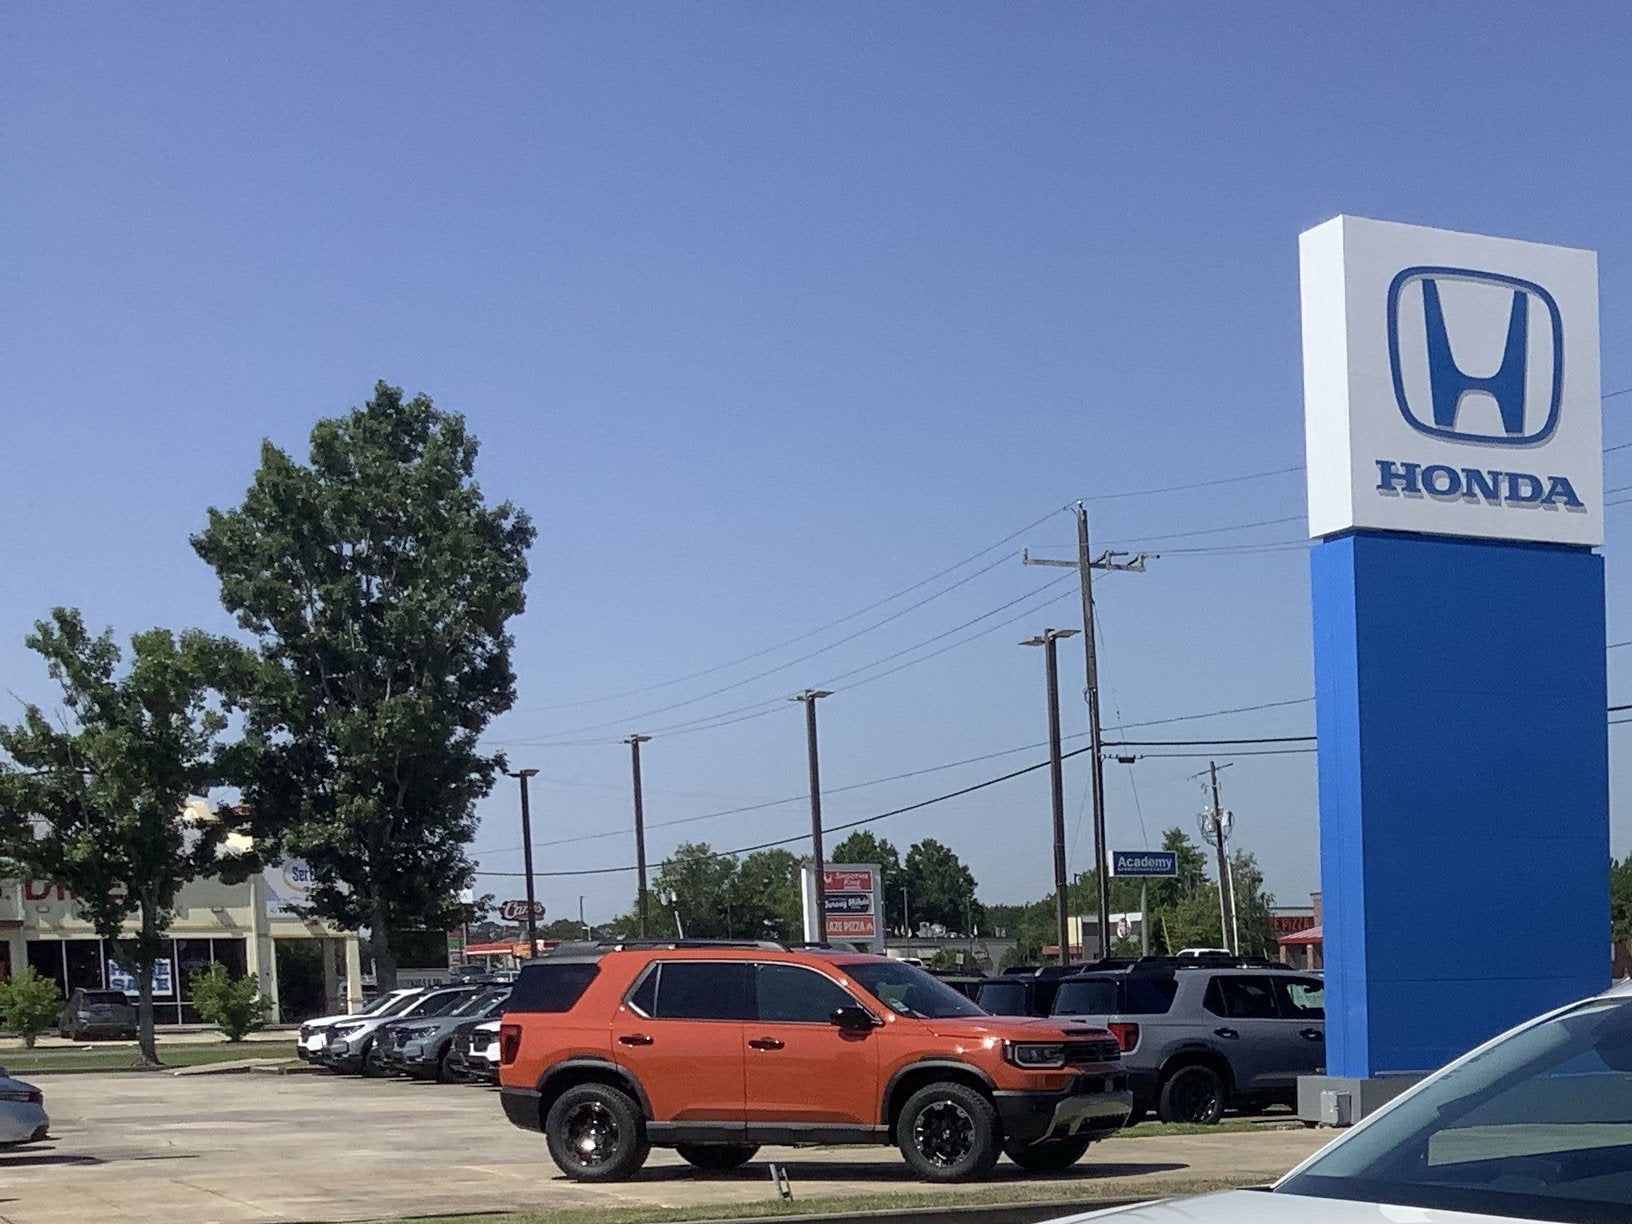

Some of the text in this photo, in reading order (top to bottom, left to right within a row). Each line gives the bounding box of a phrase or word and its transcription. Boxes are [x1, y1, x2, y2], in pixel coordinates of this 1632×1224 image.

[1375, 459, 1586, 507] HONDA
[1118, 856, 1172, 870] Academy
[843, 921, 865, 932] PIZZA
